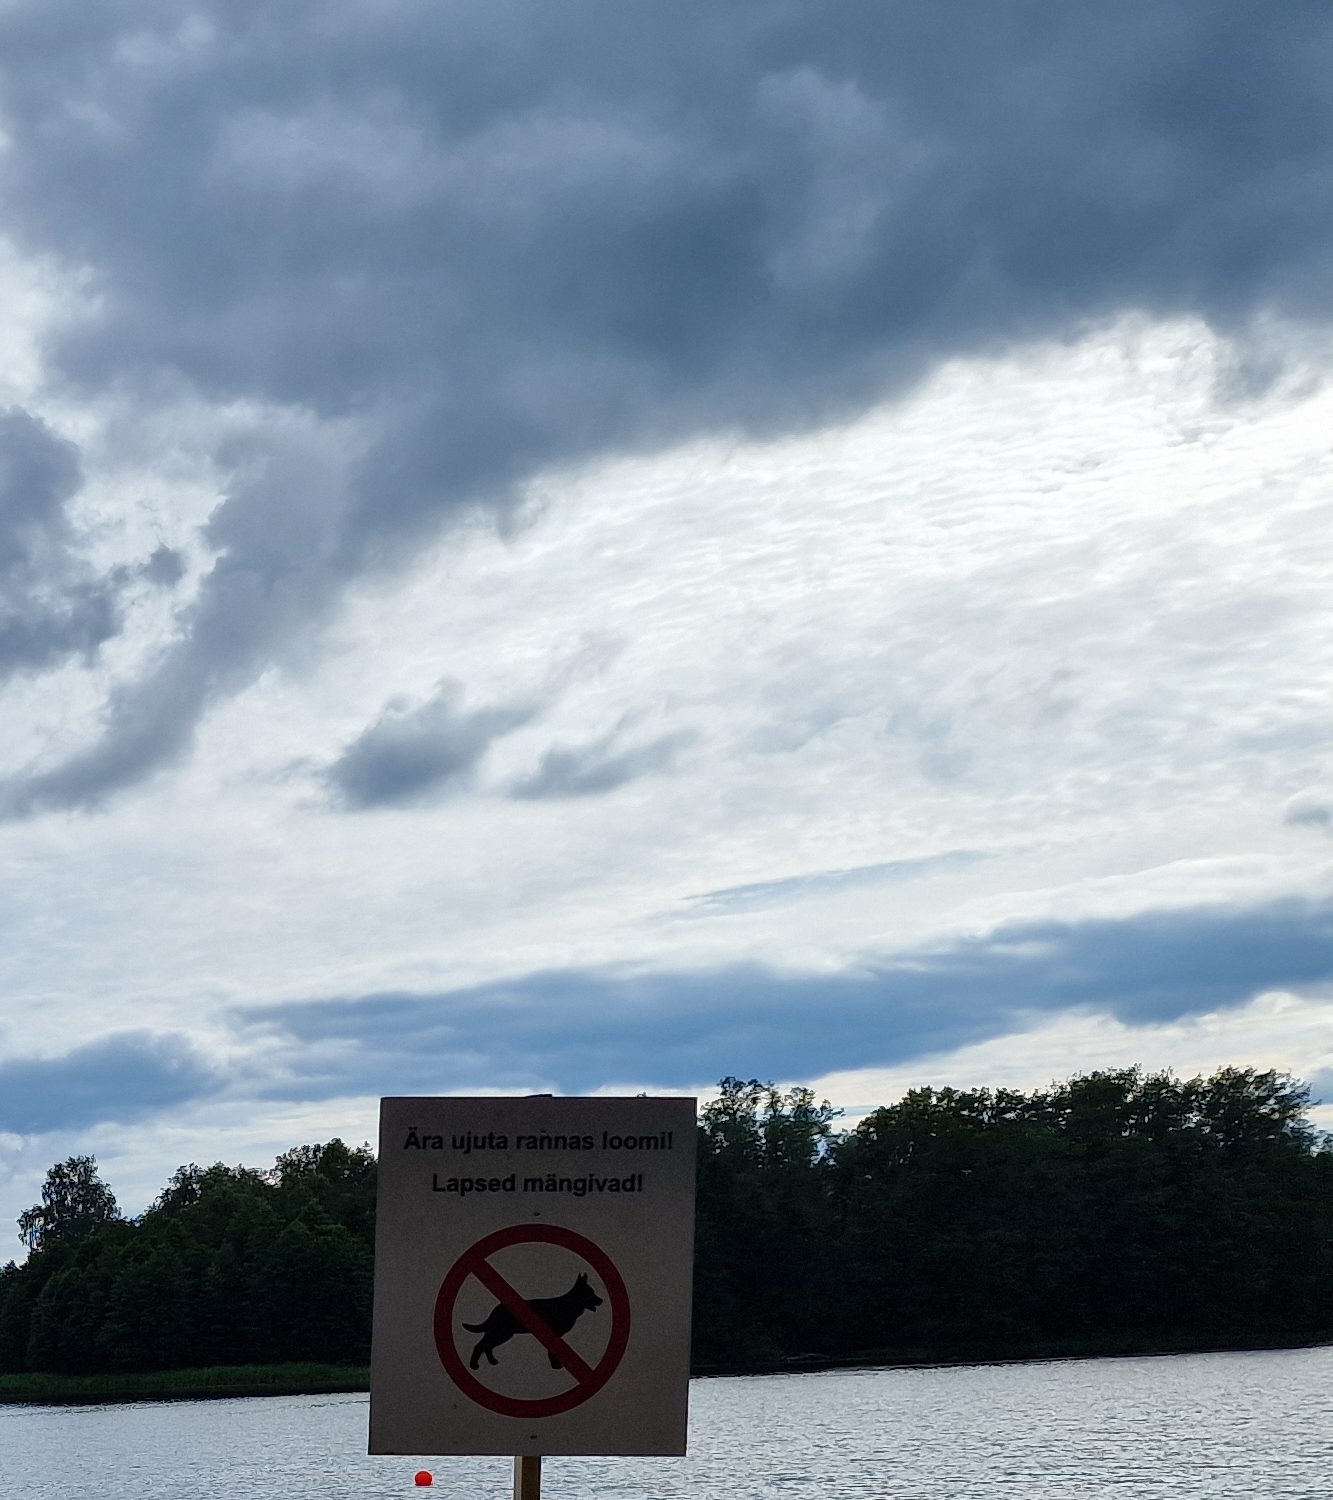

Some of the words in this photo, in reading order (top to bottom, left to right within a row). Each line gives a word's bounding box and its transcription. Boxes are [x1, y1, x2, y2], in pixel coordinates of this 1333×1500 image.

[403, 1126, 444, 1150] Ära
[451, 1131, 508, 1154] ujuta
[515, 1134, 595, 1150] rannas
[602, 1131, 673, 1150] loomi!
[432, 1173, 516, 1196] Lapsed
[523, 1173, 643, 1197] mängivad!
